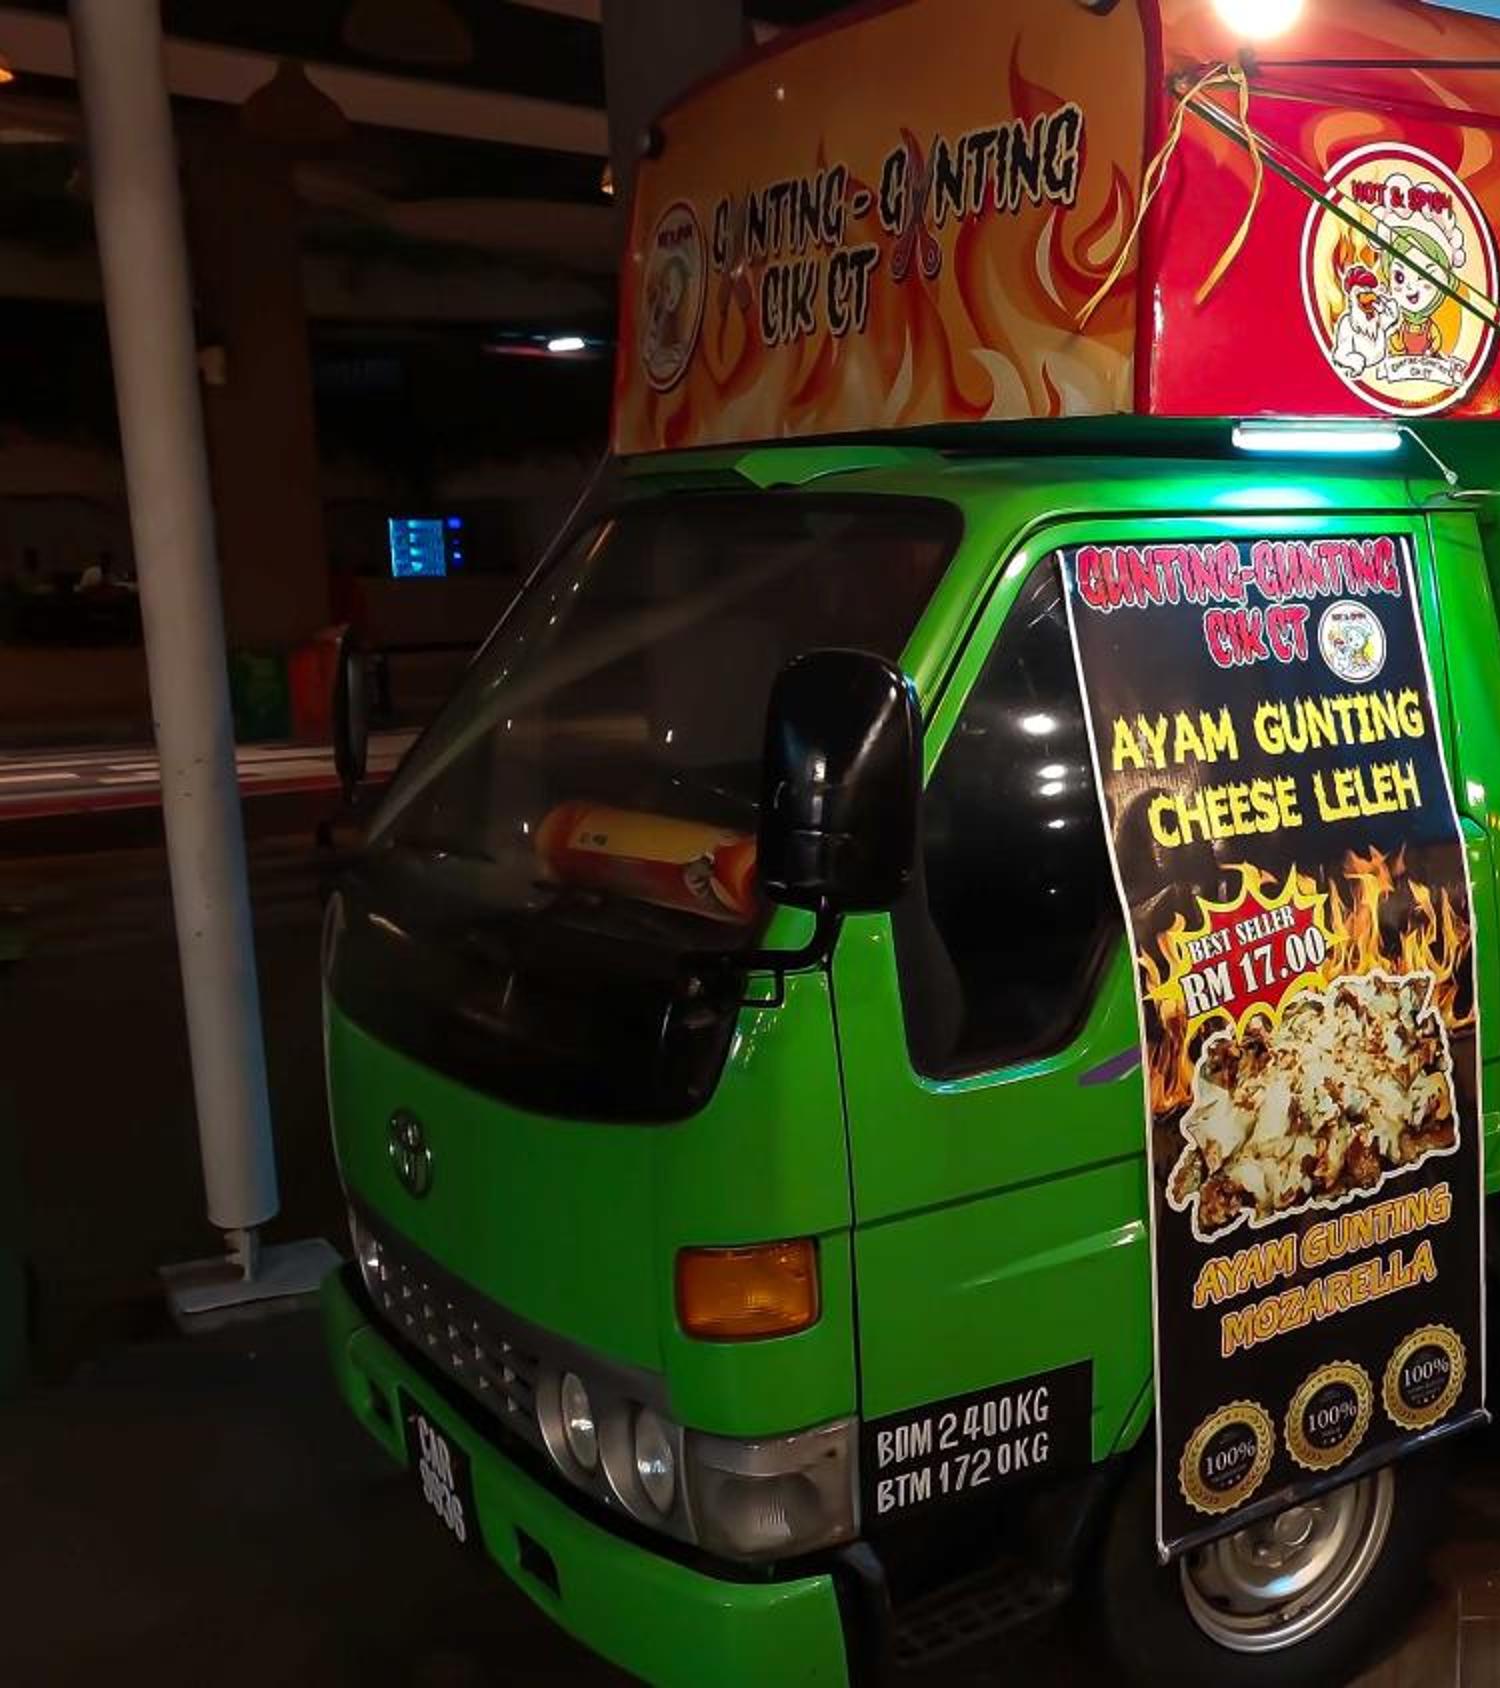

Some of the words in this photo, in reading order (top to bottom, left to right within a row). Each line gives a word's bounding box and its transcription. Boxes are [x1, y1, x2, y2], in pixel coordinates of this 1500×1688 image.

[760, 259, 820, 347] CIK
[828, 246, 878, 339] CT
[1205, 606, 1268, 668] CIK
[1267, 604, 1309, 662] CT
[1112, 705, 1239, 771] AYAM
[1253, 688, 1424, 755] GUNTING
[1147, 774, 1302, 848] CHEESE
[1313, 758, 1422, 823] LELEH
[1187, 929, 1230, 965] BEST
[1235, 905, 1295, 943] SELLER
[1180, 968, 1235, 1017] RM
[1240, 927, 1327, 993] 17.00
[1192, 1233, 1298, 1308] AYAM
[1301, 1182, 1452, 1267] GUNTING
[1221, 1239, 1438, 1358] MOZARELLA
[1403, 1359, 1450, 1388] 100%
[877, 1419, 932, 1468] BDM
[1308, 1401, 1357, 1433] 100%
[877, 1468, 931, 1513] BTM
[1205, 1441, 1256, 1477] 100%
